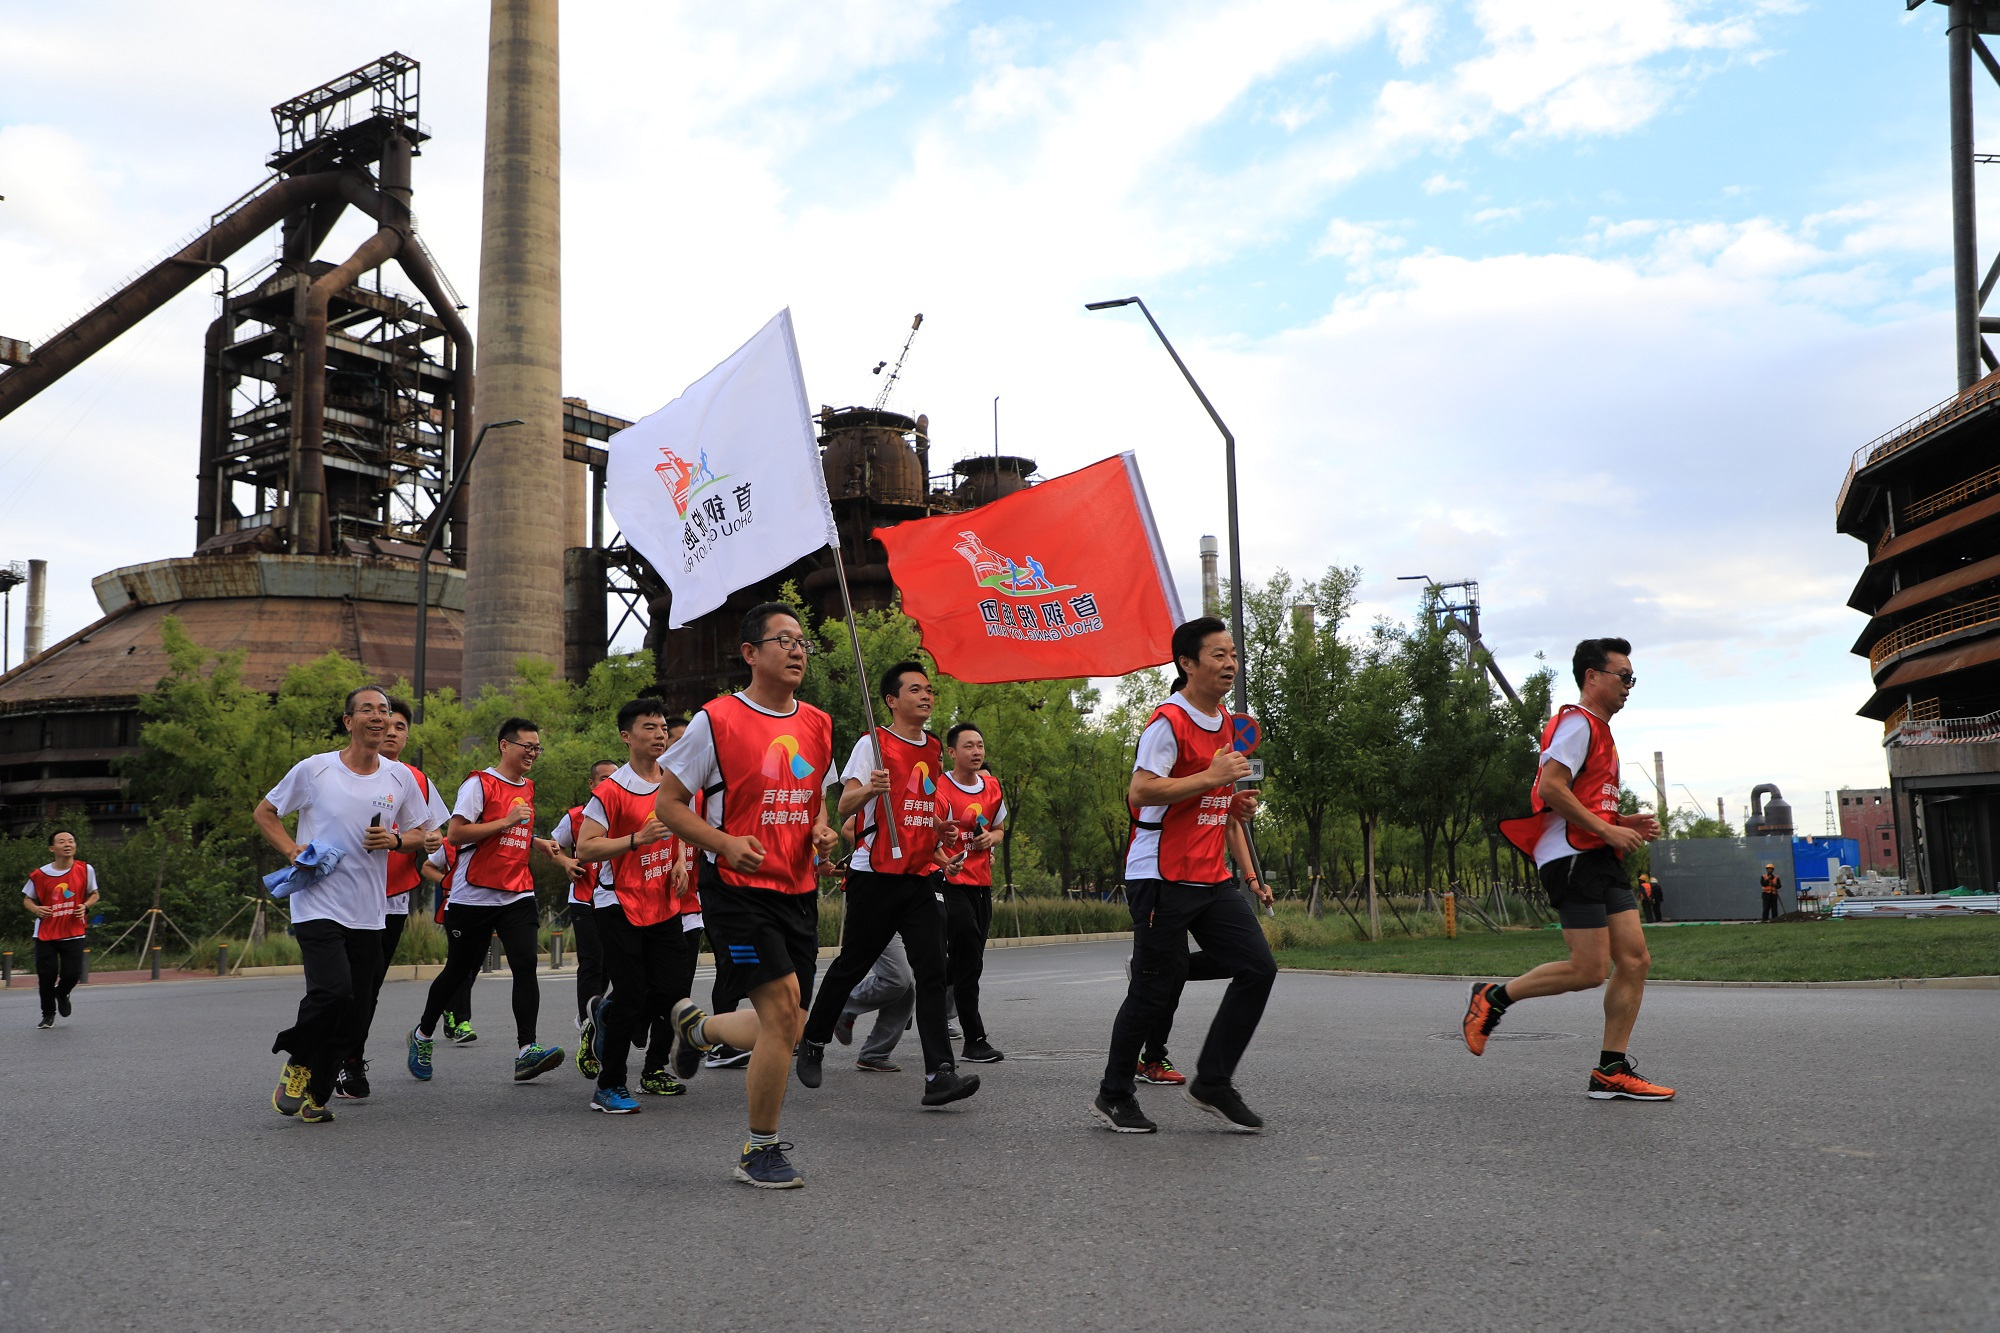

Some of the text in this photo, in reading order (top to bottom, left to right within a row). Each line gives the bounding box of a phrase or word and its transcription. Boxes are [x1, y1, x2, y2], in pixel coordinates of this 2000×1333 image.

[904, 800, 934, 812] 百年首钢
[761, 810, 809, 825] 快跑中国
[904, 815, 934, 827] 快跑中国
[499, 836, 527, 850] 快跑中国
[640, 845, 672, 866] 百年首
